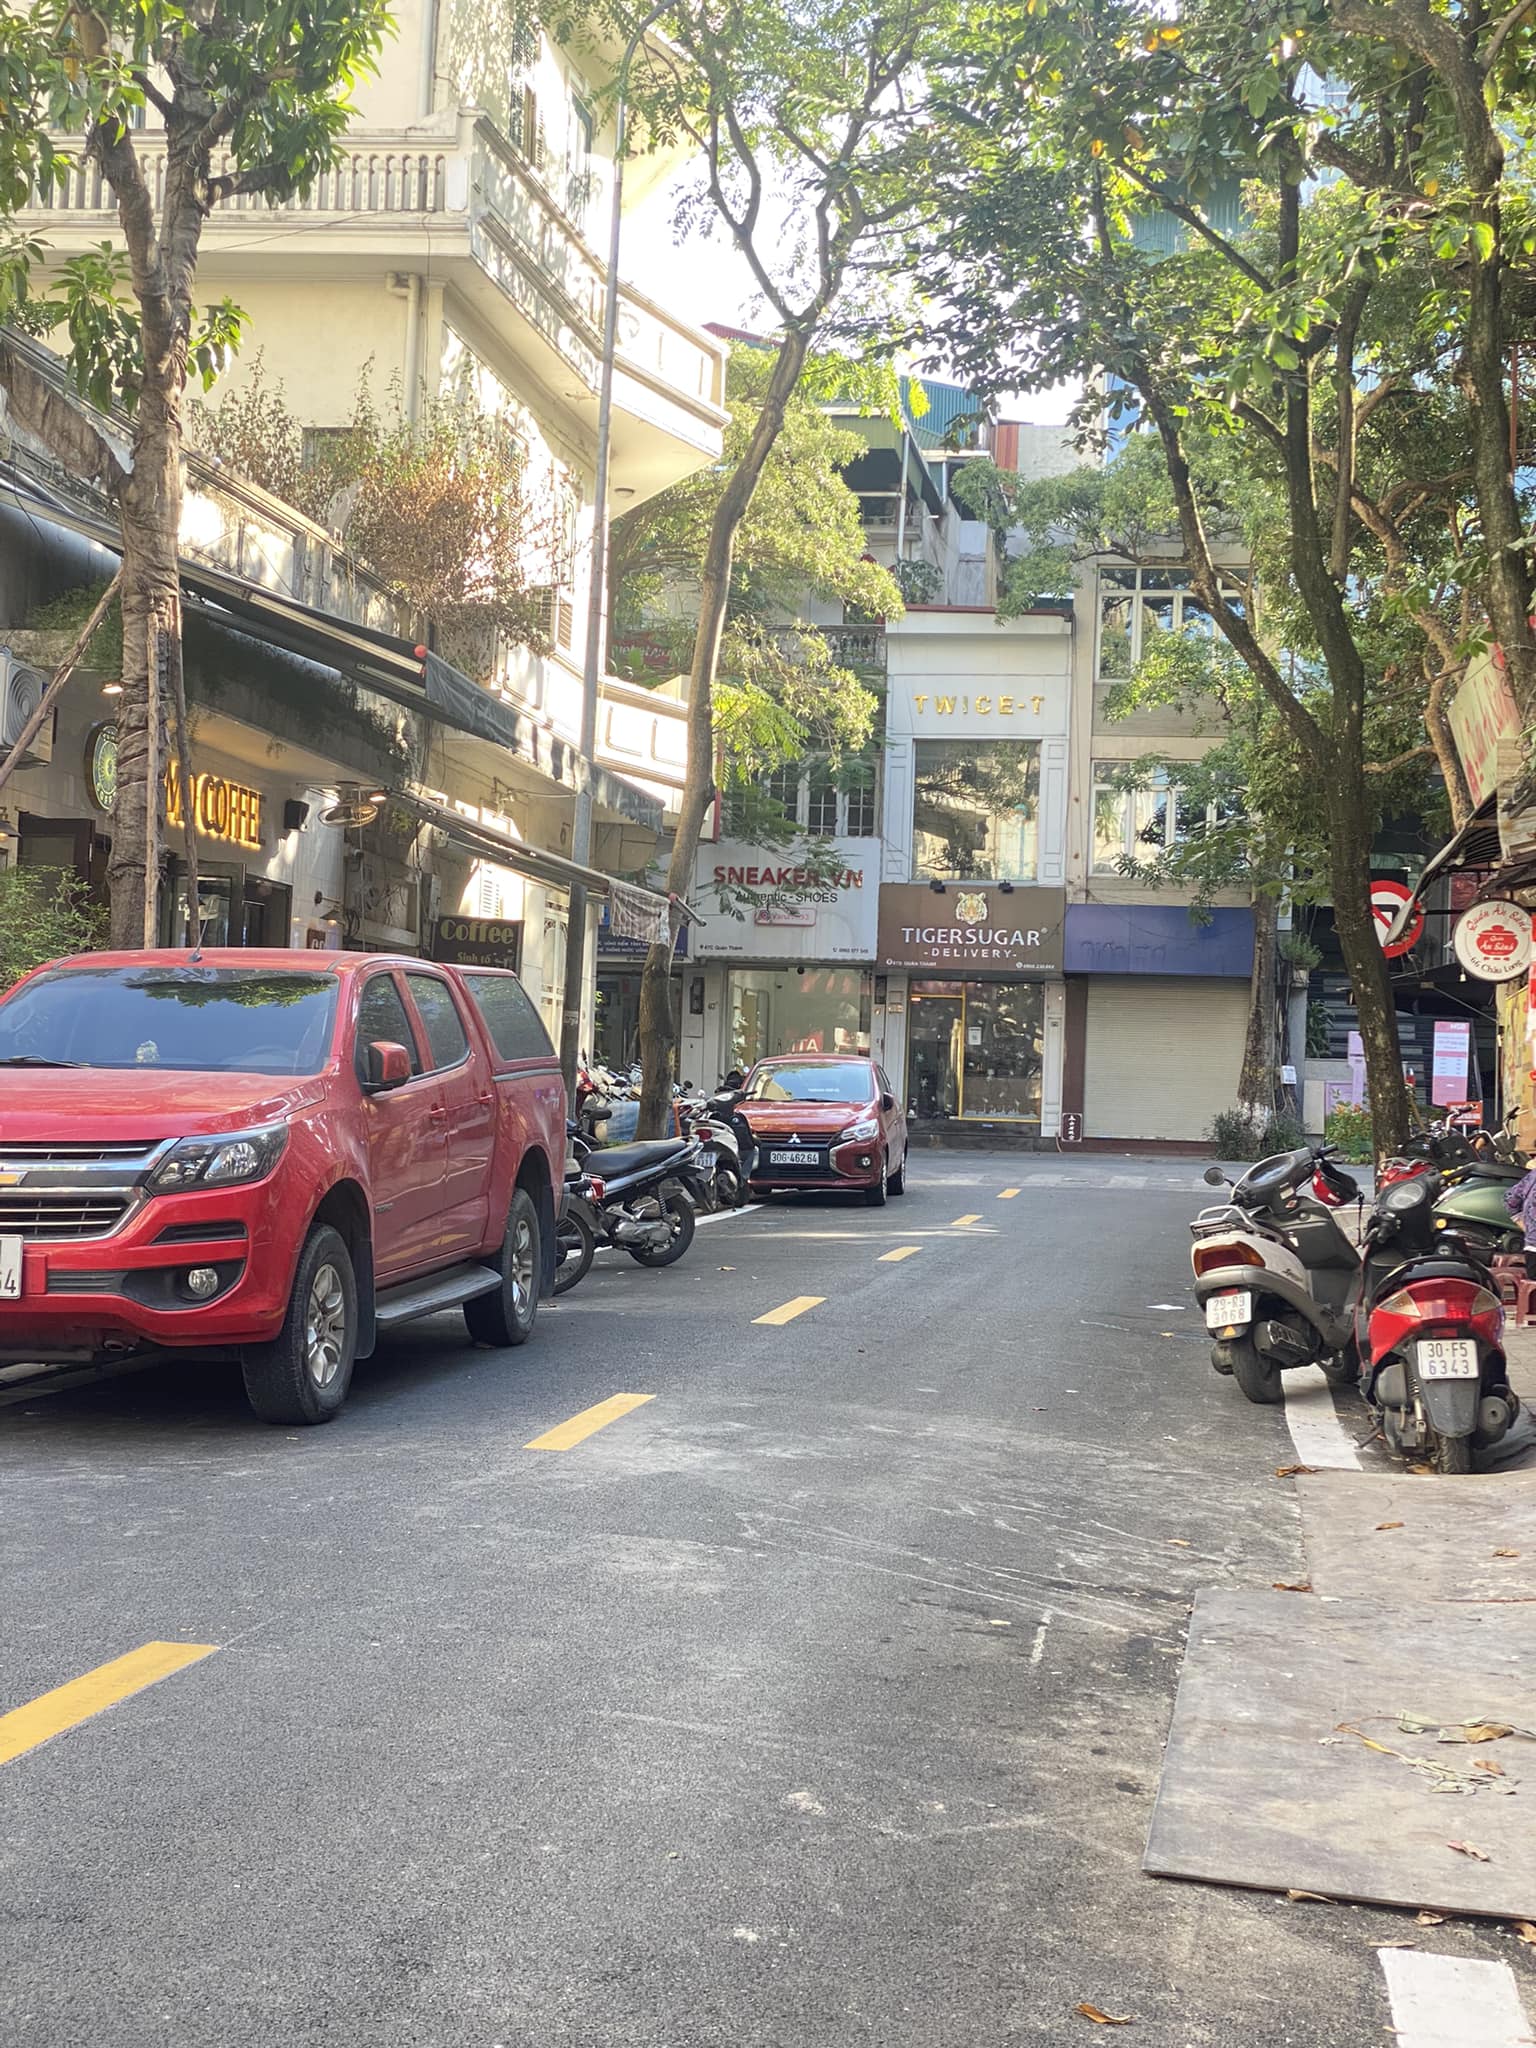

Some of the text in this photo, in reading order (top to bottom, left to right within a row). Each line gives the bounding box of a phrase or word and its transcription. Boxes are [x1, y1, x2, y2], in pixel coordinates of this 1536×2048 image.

[913, 695, 1045, 714] TWICE-T
[200, 774, 266, 849] COFFEE
[795, 892, 838, 903] SHOES
[440, 920, 515, 944] Coffee
[1428, 1360, 1470, 1375] 6343
